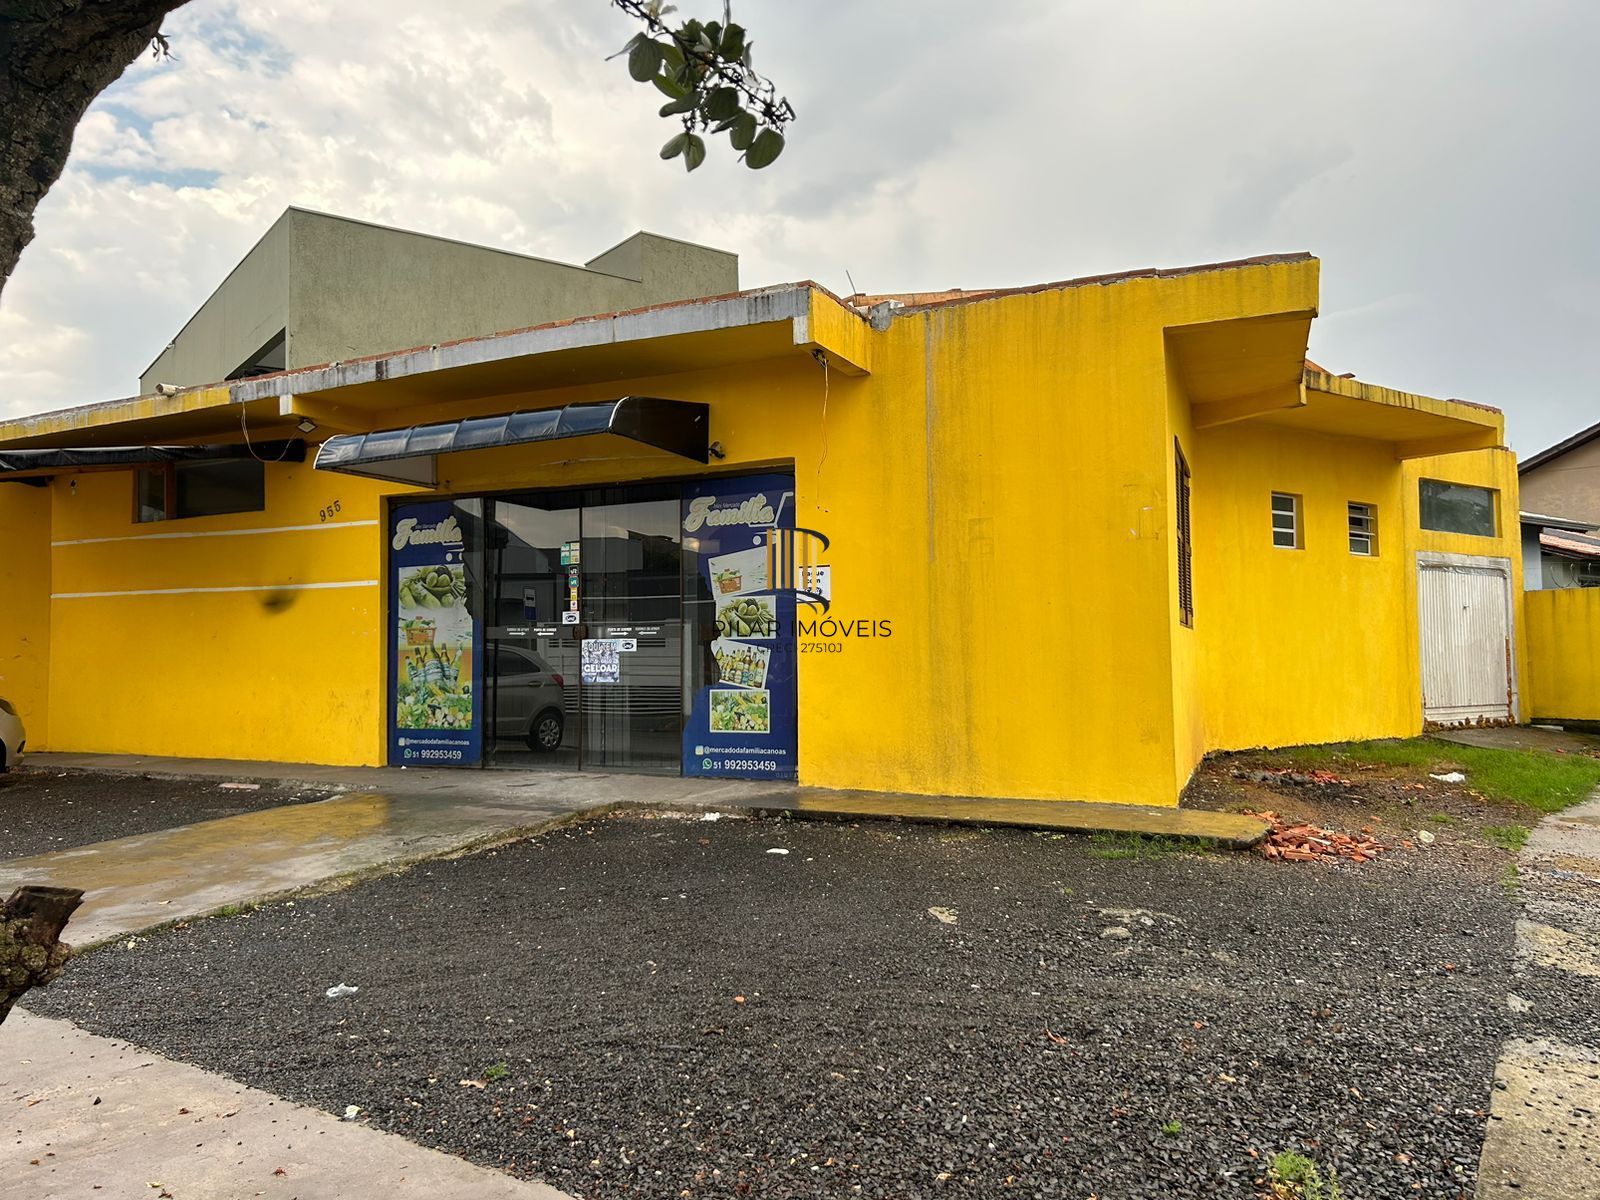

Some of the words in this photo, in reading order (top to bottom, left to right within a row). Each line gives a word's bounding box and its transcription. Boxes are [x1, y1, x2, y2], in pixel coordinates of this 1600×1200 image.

[320, 500, 341, 521] 955
[421, 750, 462, 759] 992953459
[713, 761, 721, 769] 51
[724, 760, 777, 771] 992953459
